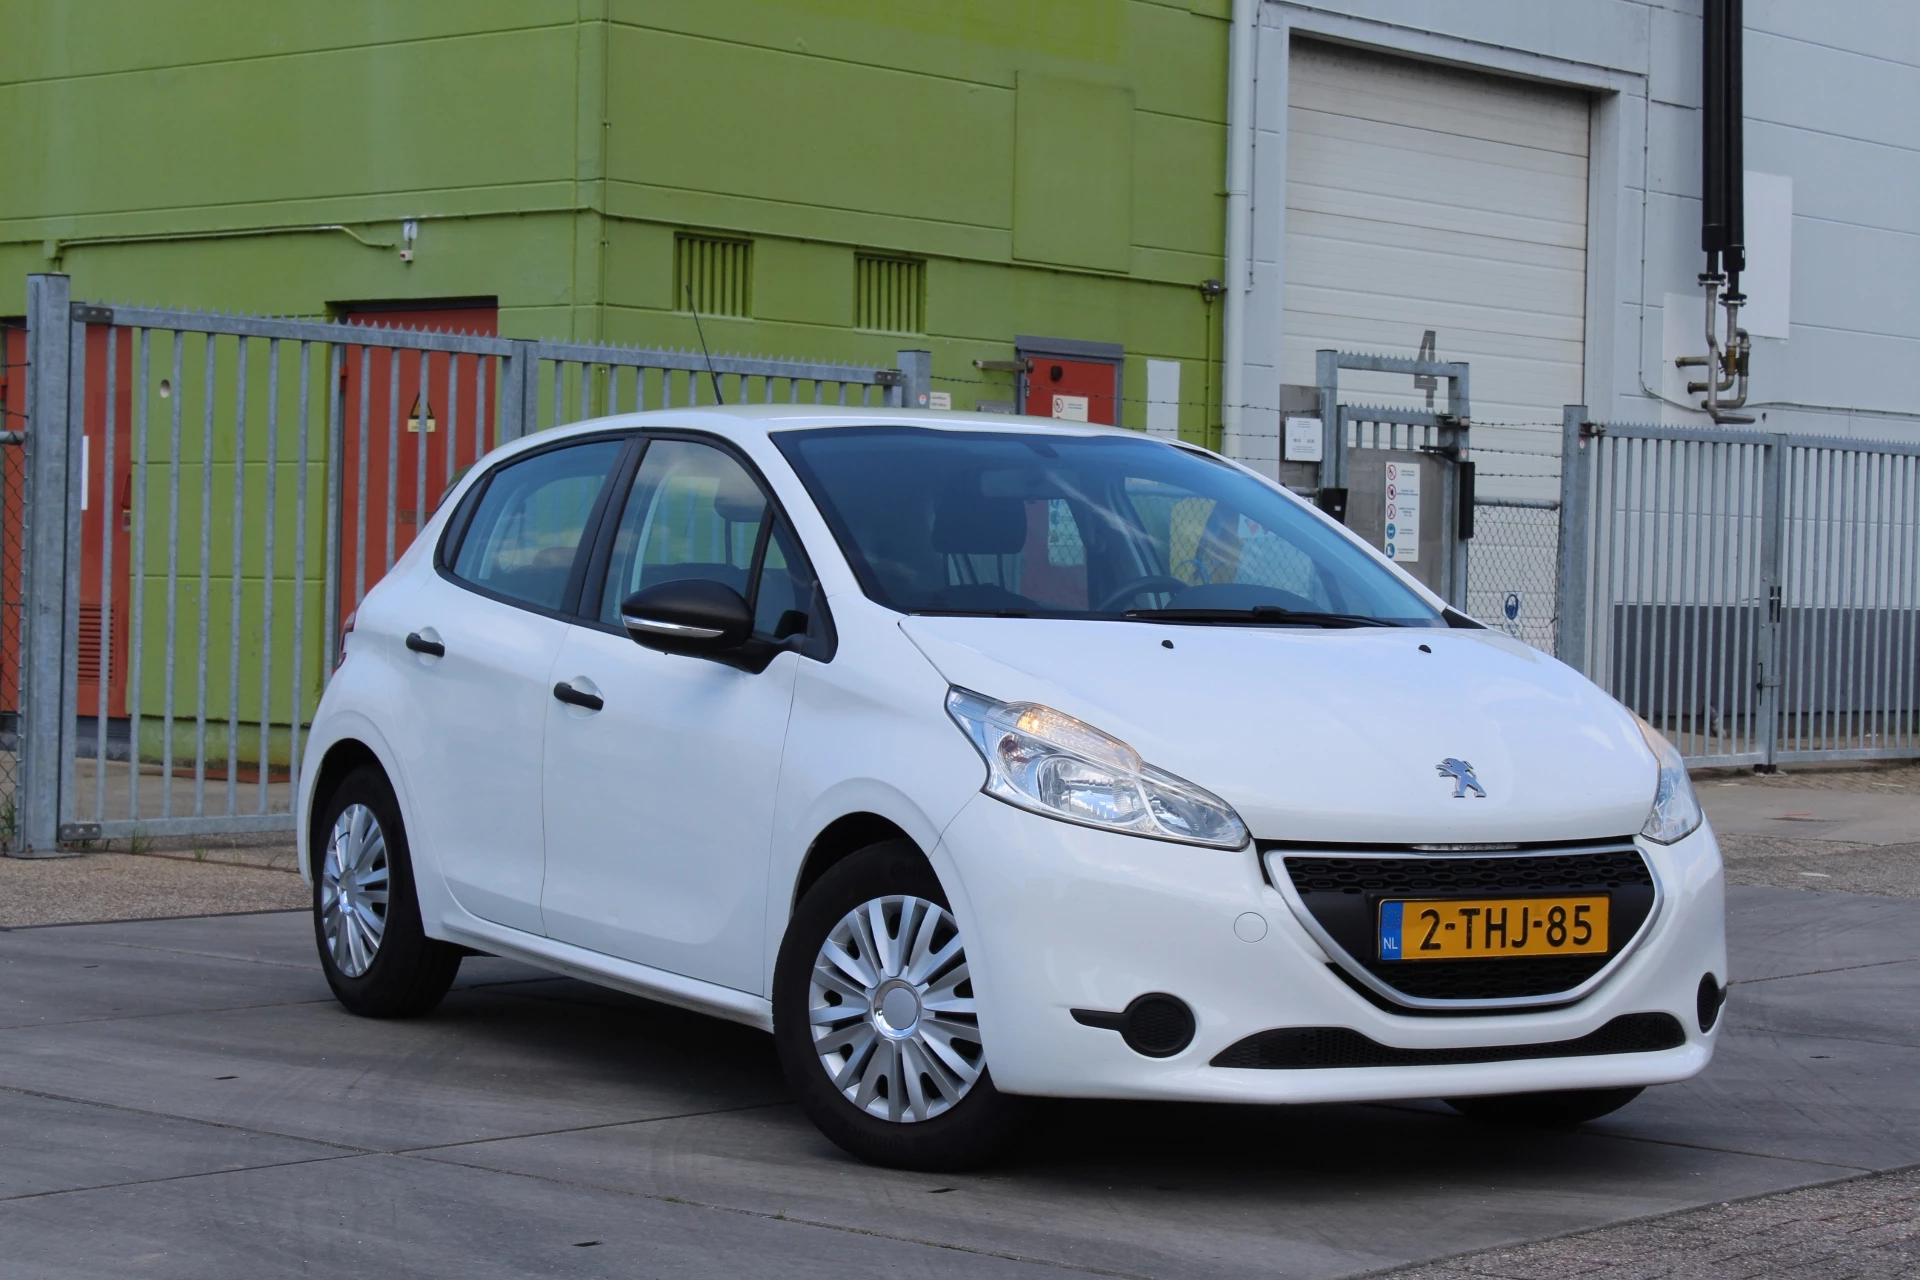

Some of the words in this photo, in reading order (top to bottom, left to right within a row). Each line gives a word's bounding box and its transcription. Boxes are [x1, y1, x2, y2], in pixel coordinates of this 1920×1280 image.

[1414, 330, 1437, 408] 4
[1383, 937, 1399, 950] NL
[1420, 905, 1592, 950] 2-THJ-85
